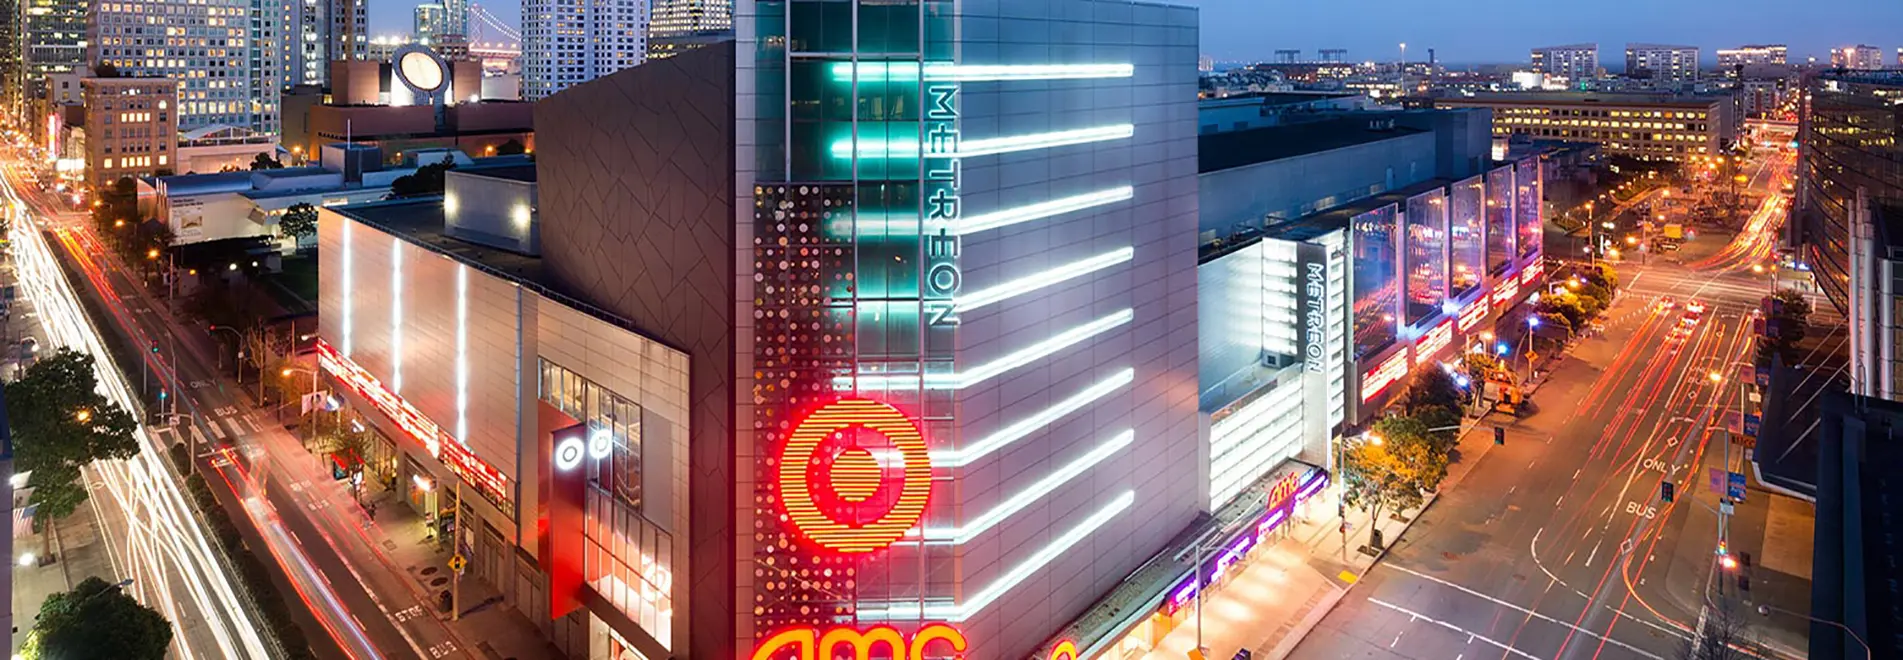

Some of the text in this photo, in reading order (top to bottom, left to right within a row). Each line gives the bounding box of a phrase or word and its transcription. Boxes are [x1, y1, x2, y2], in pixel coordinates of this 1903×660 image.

[928, 84, 961, 327] METREON
[1306, 262, 1325, 374] METREON
[214, 405, 239, 417] BUS
[1643, 458, 1681, 476] ONLY
[1626, 501, 1657, 519] BUS
[395, 604, 424, 623] STOP
[429, 641, 457, 659] BUS
